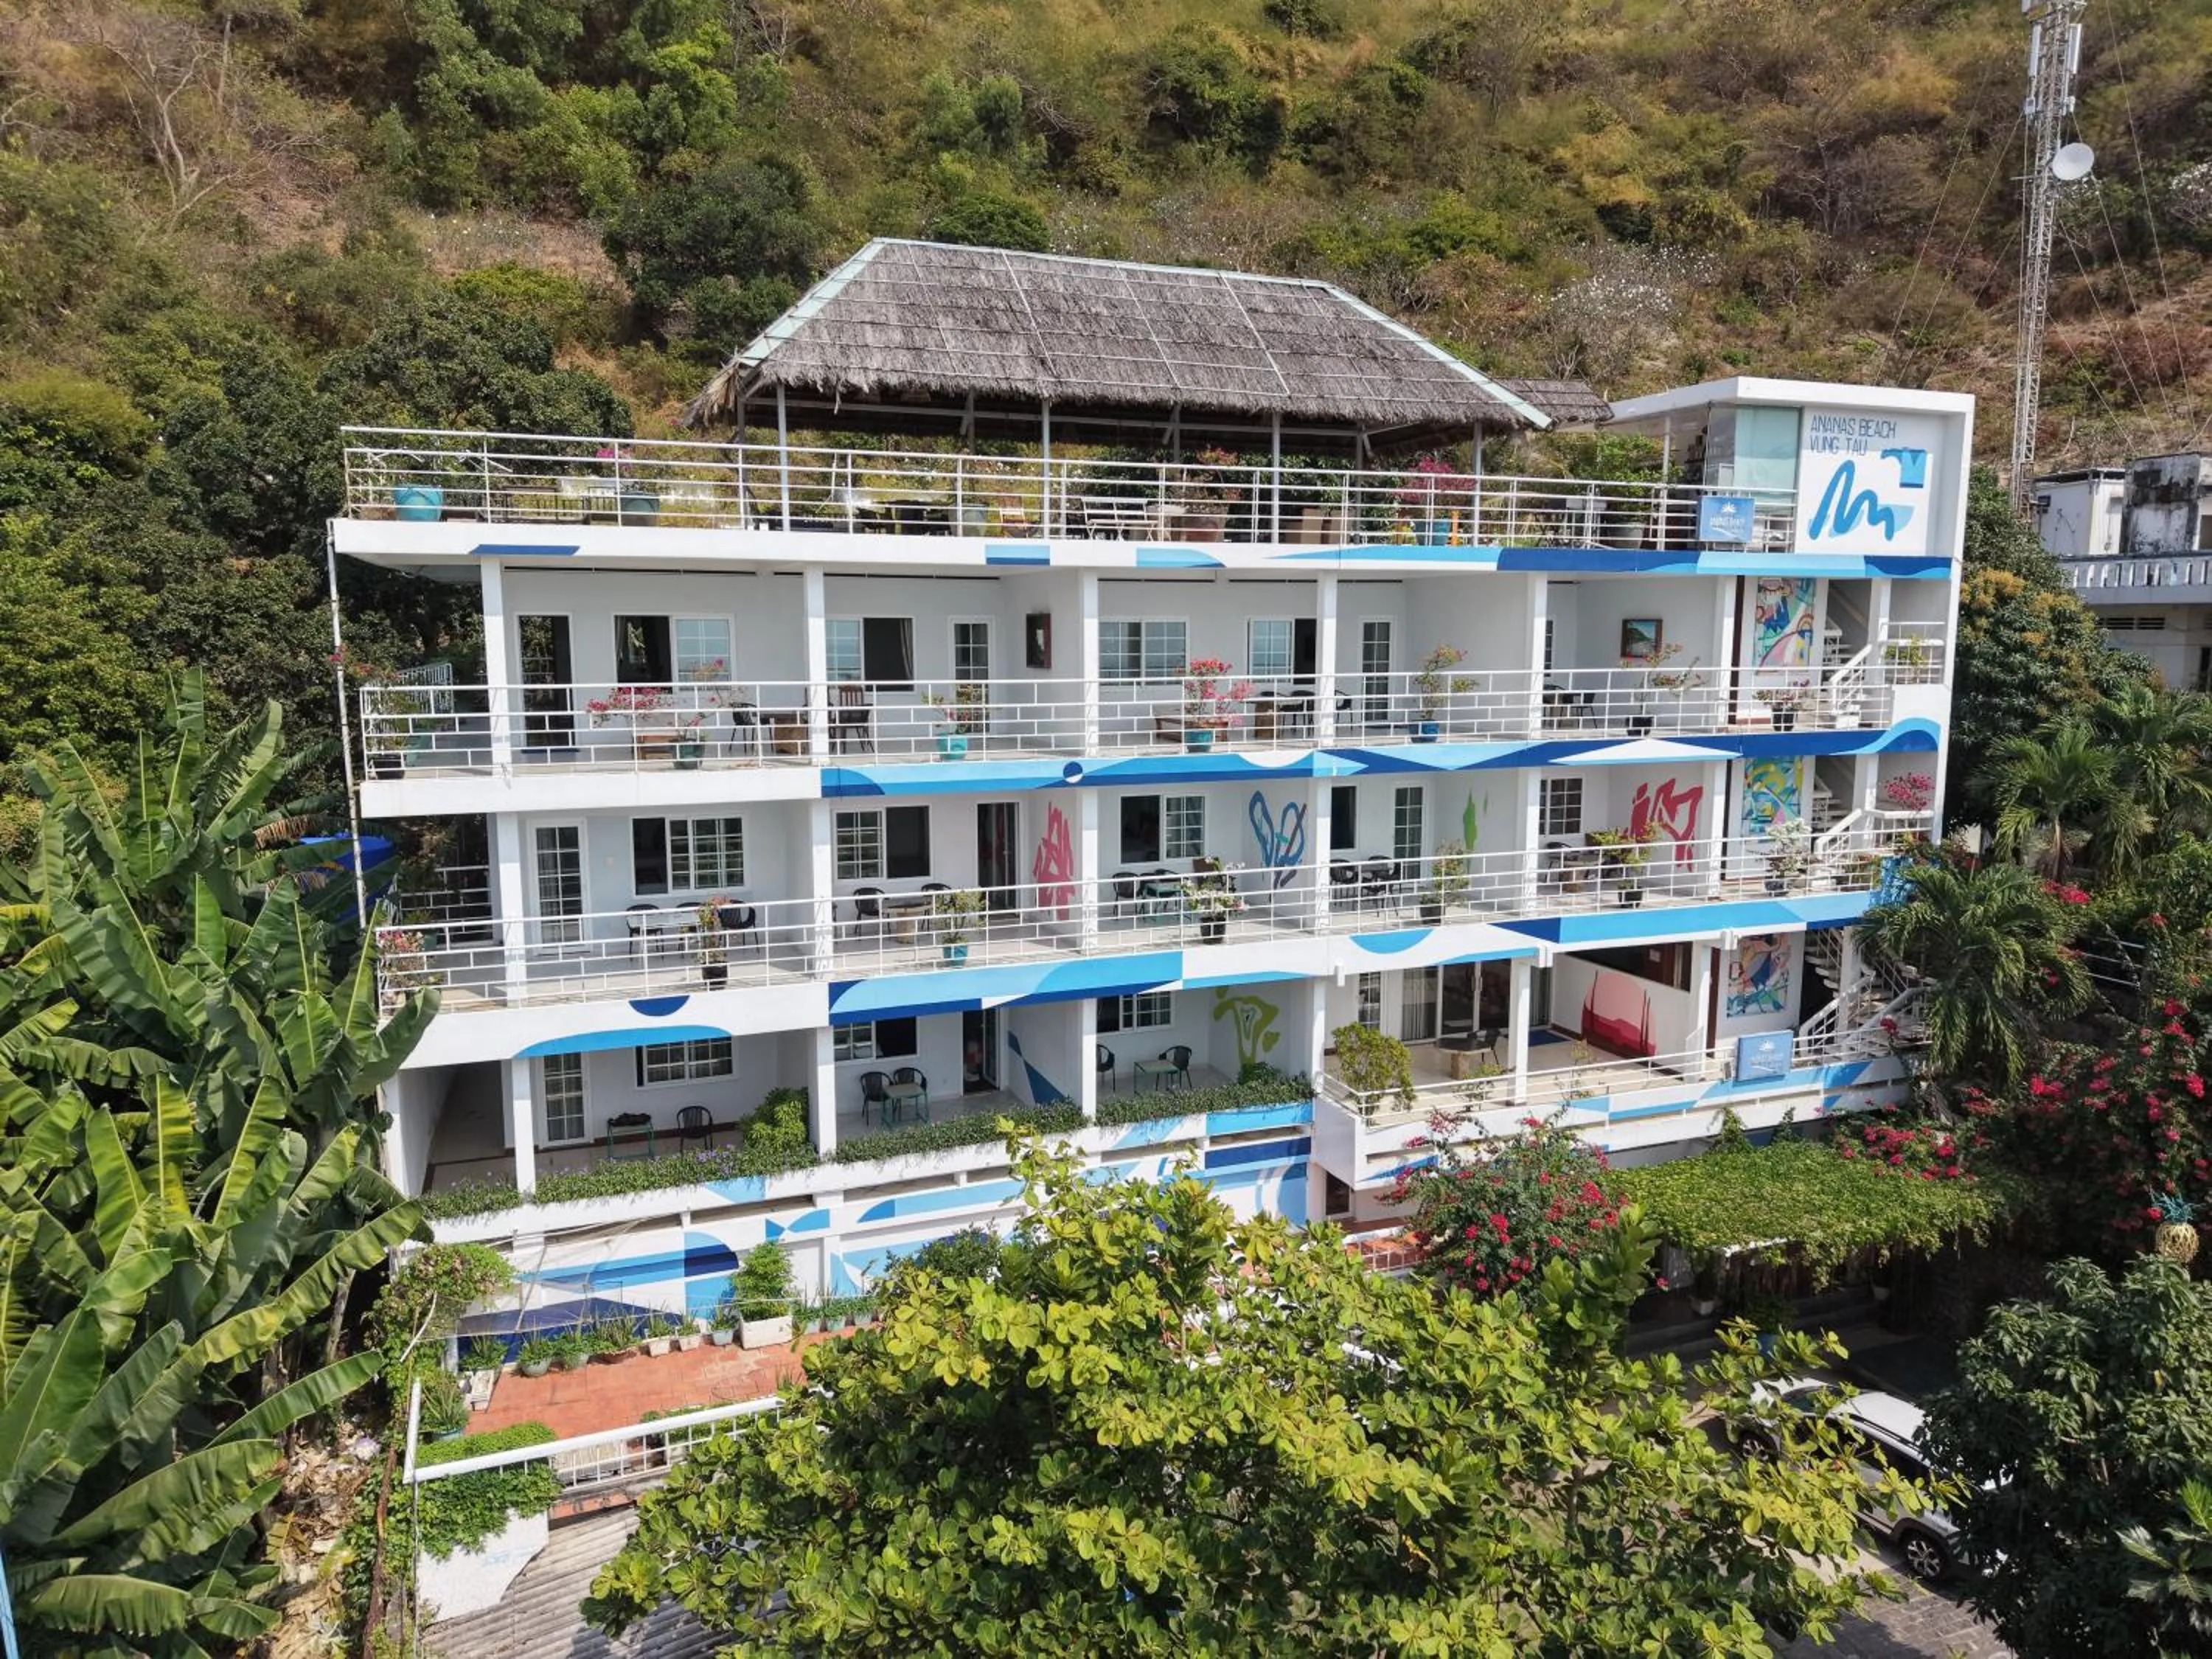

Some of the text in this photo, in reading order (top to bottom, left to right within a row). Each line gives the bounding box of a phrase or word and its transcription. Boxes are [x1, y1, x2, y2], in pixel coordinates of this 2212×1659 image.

[1811, 415, 1897, 439] ANANAS BEACH
[1846, 437, 1868, 456] TAU
